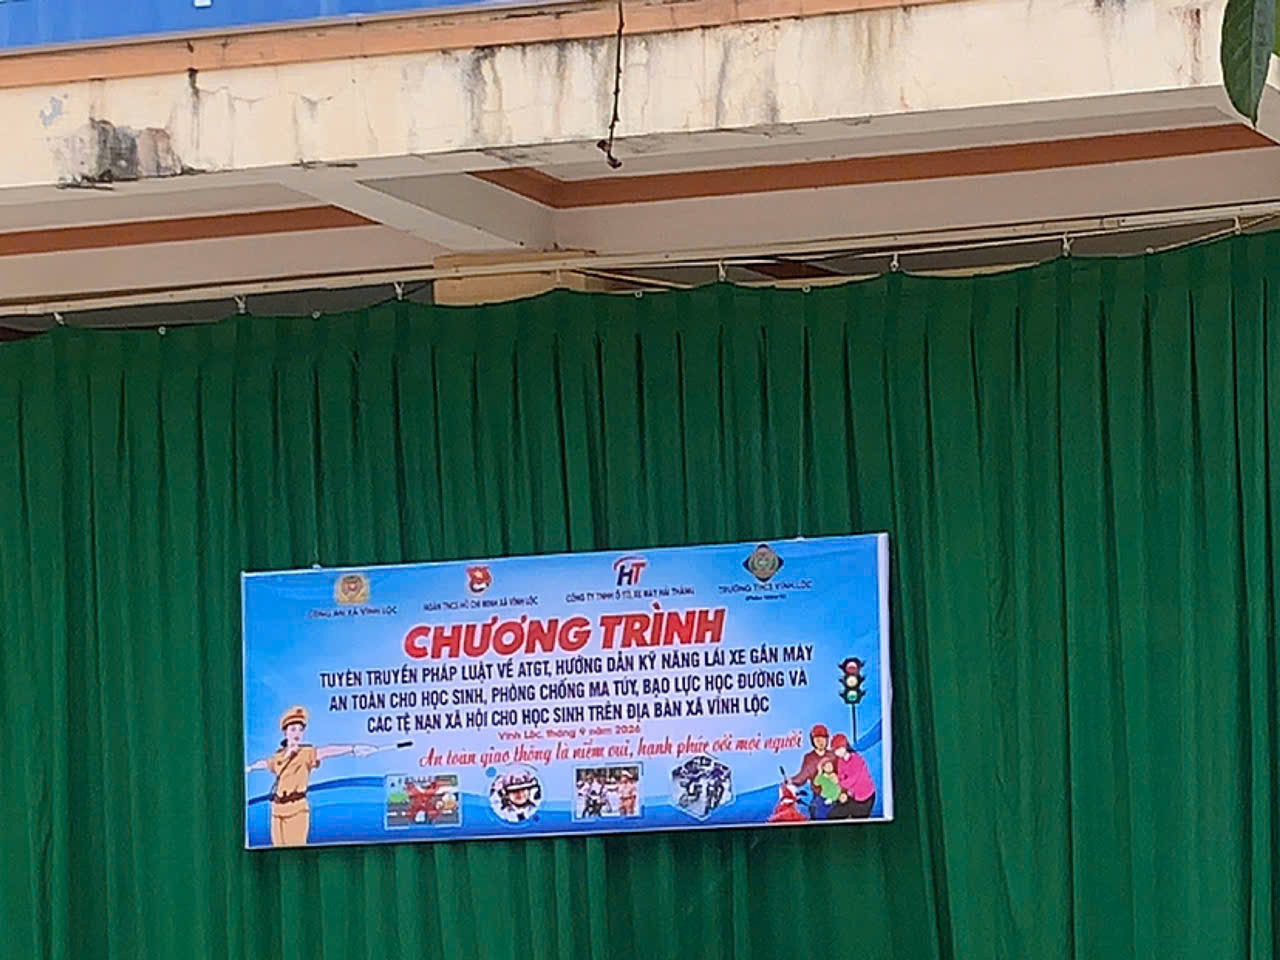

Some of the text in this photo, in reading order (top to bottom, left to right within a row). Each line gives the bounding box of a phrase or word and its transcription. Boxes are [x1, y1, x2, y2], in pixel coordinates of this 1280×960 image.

[404, 602, 726, 660] CHƯƠNG TRÌNH
[320, 668, 362, 688] TUYÊN
[422, 662, 457, 684] PHÁP
[461, 661, 493, 684] LUẬT
[518, 660, 551, 678] ATGT,
[704, 647, 725, 666] LÁI
[729, 649, 746, 665] XE
[783, 644, 813, 663] MÁY
[329, 666, 808, 711] AN TOÀN CHO HỌC SINH, PHÒNG CHỐNG MA TÚY, BẠO LỰC HỌC ĐƯỜNG VÀ
[368, 712, 392, 733] CÁC
[415, 713, 441, 734] NẠN
[445, 710, 462, 729] XÃ
[466, 708, 488, 731] HỘI
[491, 709, 518, 726] CHO
[522, 708, 550, 728] HỌC
[553, 706, 584, 723] SINH
[588, 701, 622, 722] TRÊN
[627, 703, 650, 722] ĐỊA
[654, 697, 682, 718] BÀN
[686, 696, 703, 716] XÃ
[707, 695, 740, 715] VĨNH
[744, 694, 770, 716] LỘC
[419, 747, 442, 767] An
[446, 747, 476, 765] toàn
[480, 746, 510, 768] giao
[514, 743, 552, 766] thông
[556, 741, 569, 760] là
